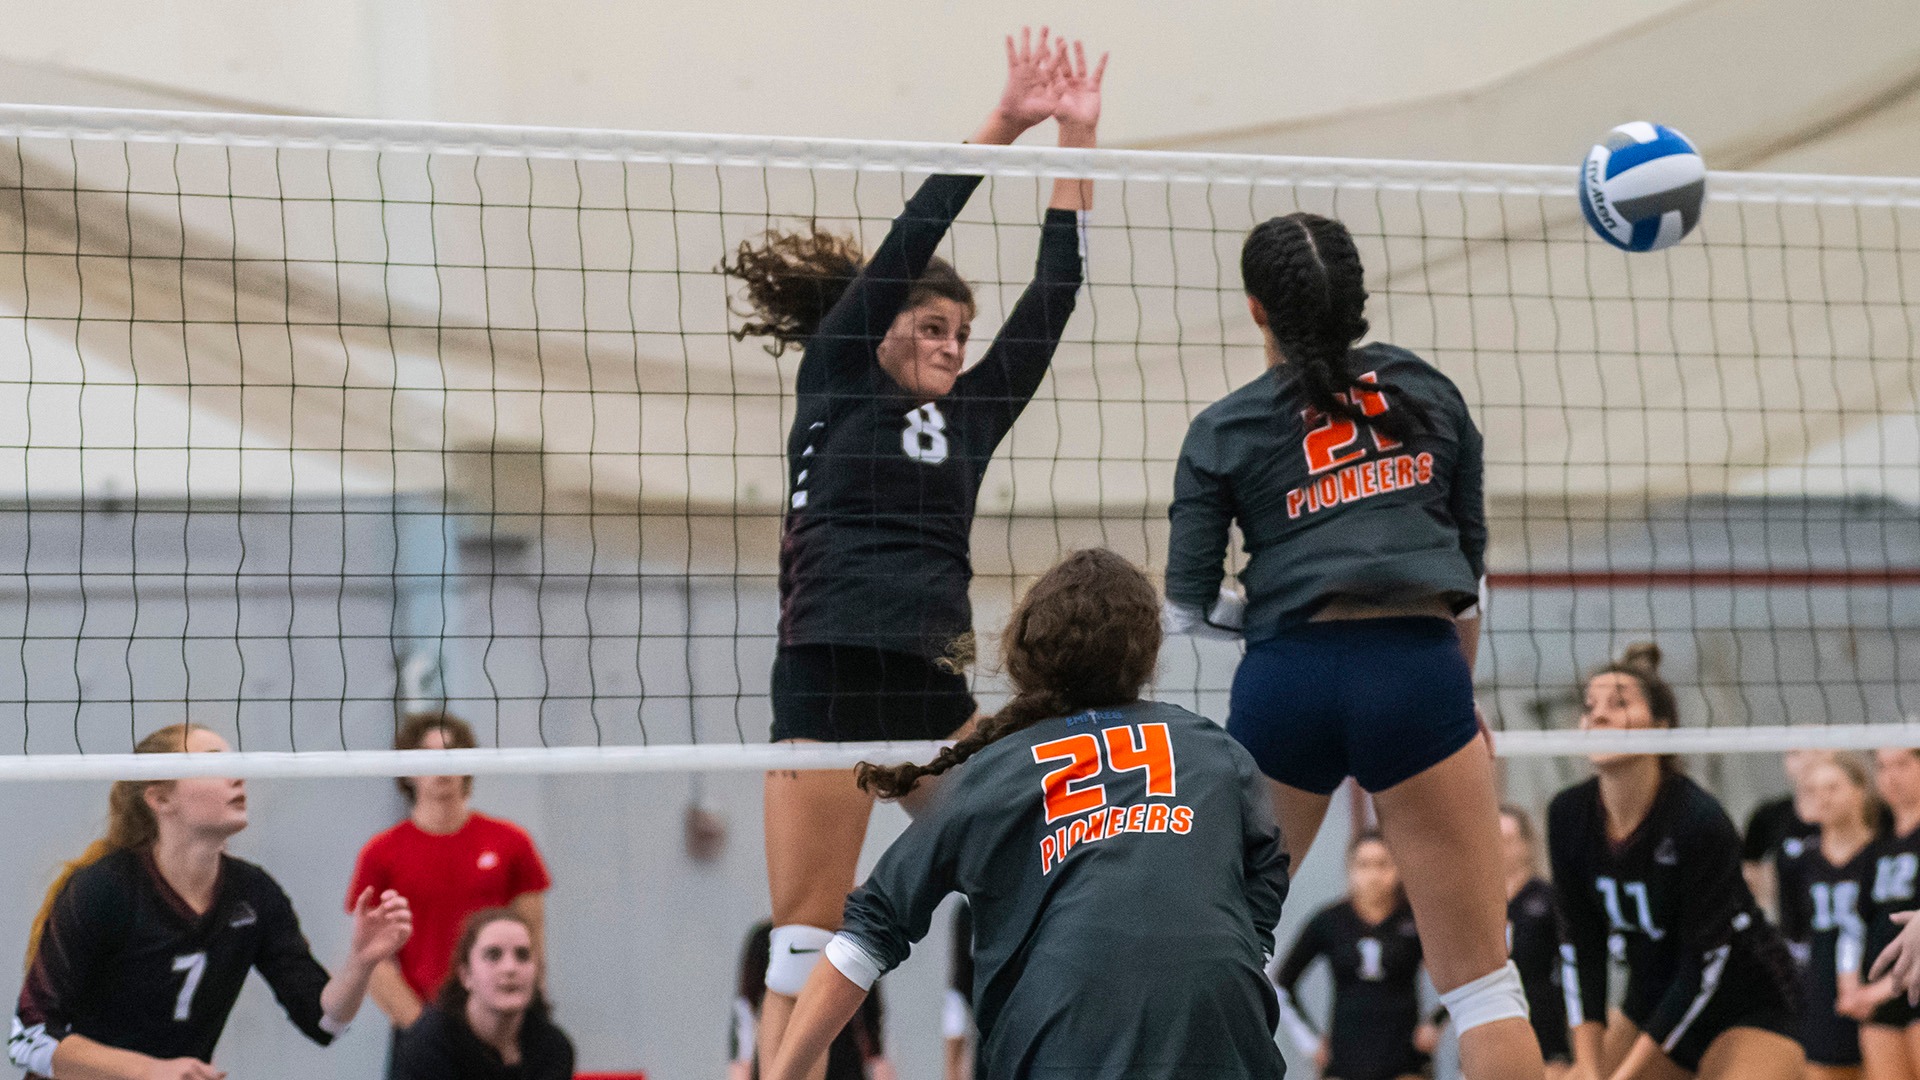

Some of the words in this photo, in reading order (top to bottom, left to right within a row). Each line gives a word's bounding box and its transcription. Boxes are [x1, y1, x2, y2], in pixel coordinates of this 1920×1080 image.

[902, 401, 948, 465] 8
[1301, 370, 1403, 475] 21
[1286, 452, 1434, 520] PIONEERS
[1031, 722, 1176, 825] 24
[1039, 803, 1195, 876] PIONEERS
[1595, 875, 1667, 941] 11
[171, 951, 208, 1021] 7
[1356, 936, 1384, 982] 1
